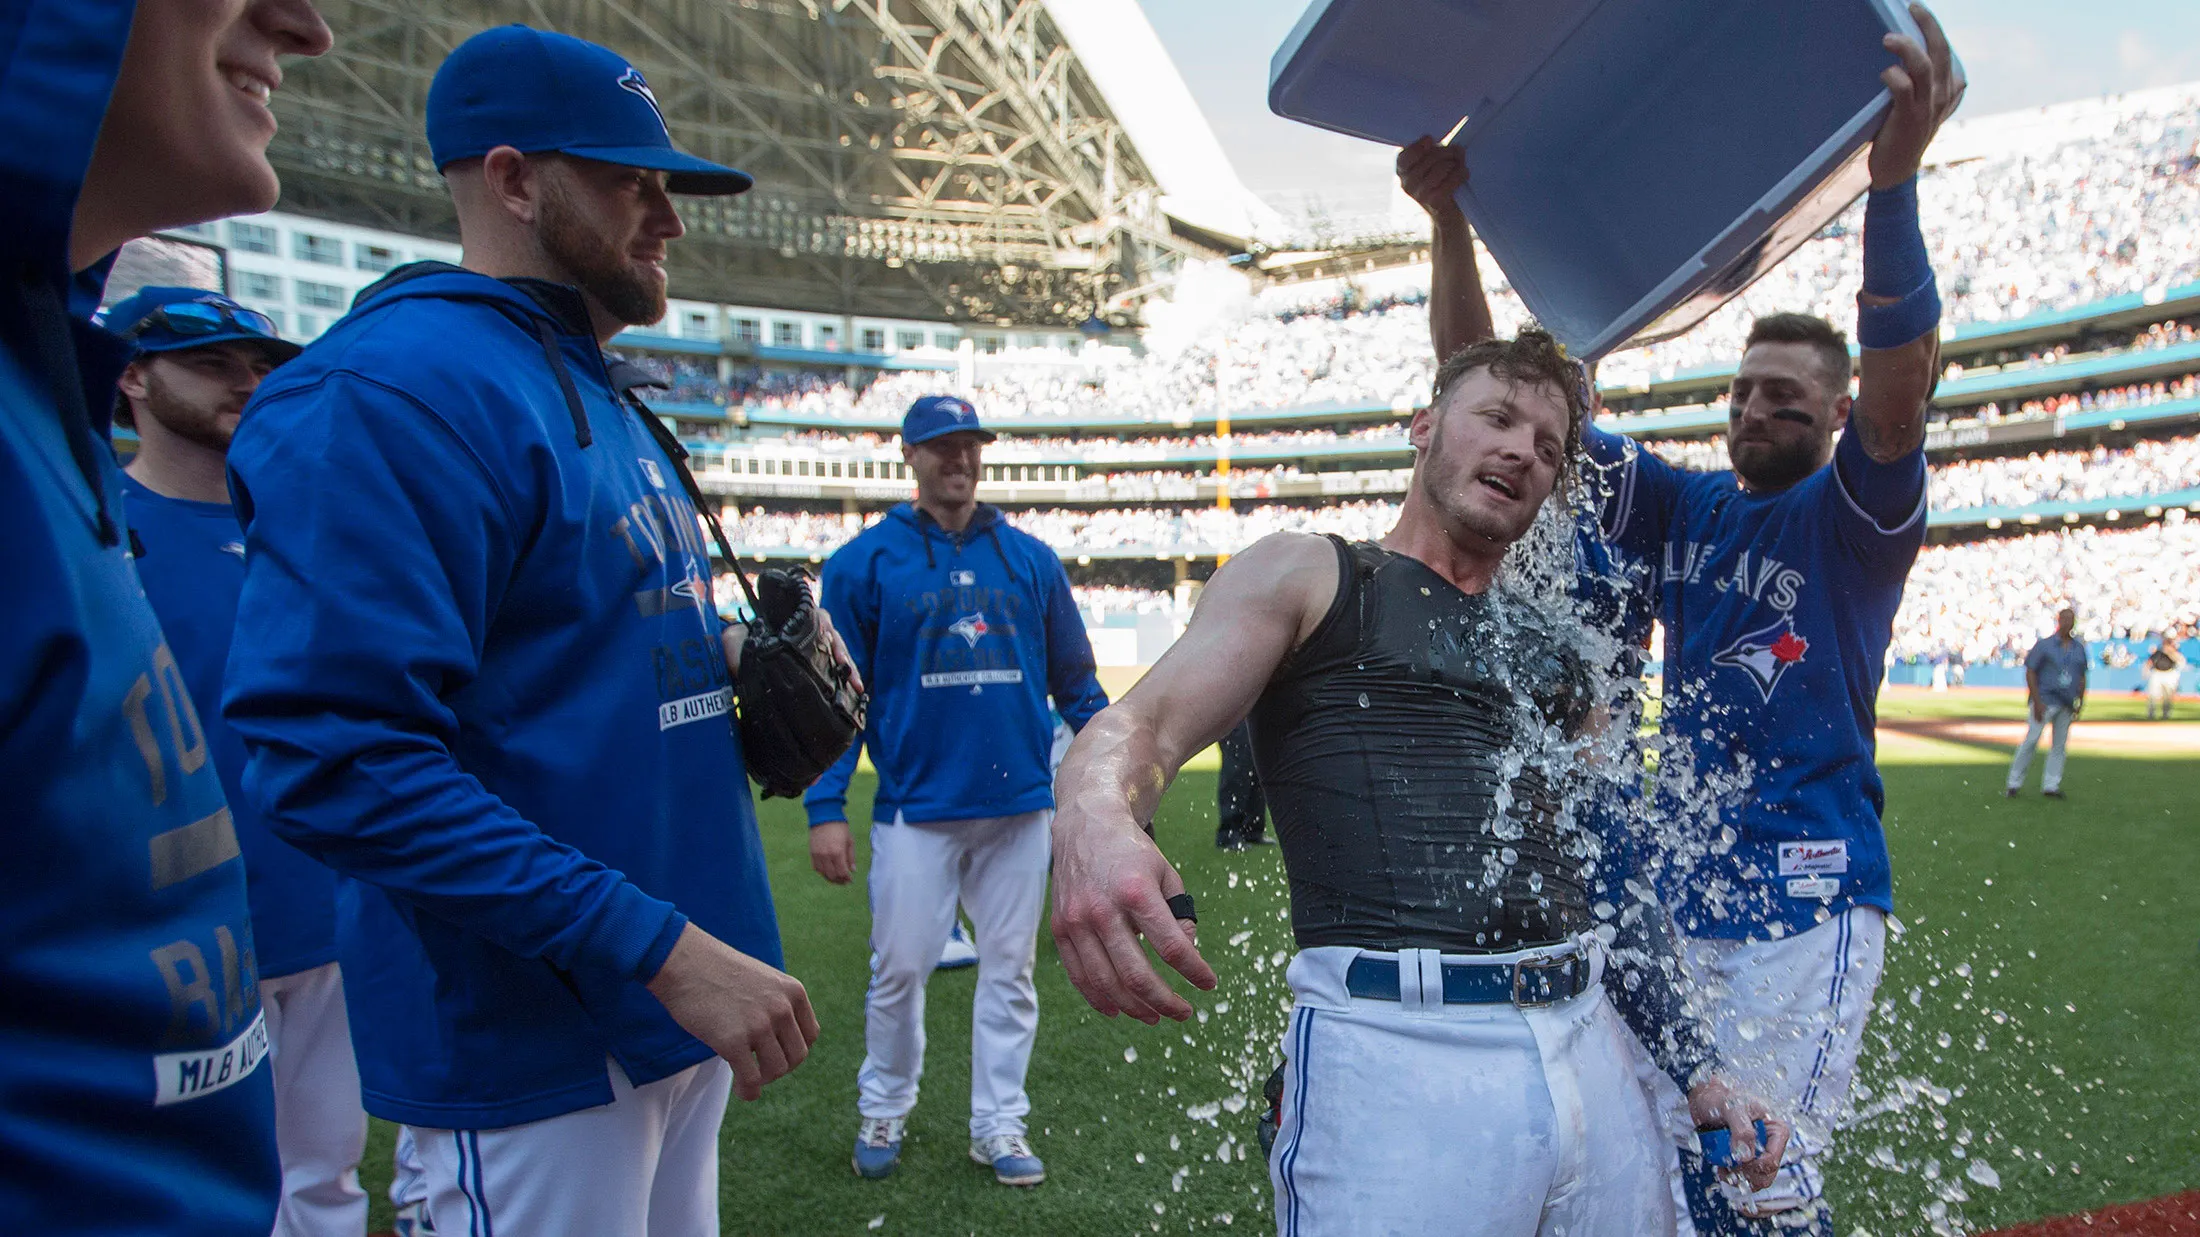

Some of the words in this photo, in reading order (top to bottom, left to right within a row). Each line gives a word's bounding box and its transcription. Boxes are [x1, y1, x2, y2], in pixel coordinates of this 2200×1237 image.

[1663, 541, 1716, 584] LUE
[661, 705, 678, 724] LB
[179, 1049, 234, 1095] MLB
